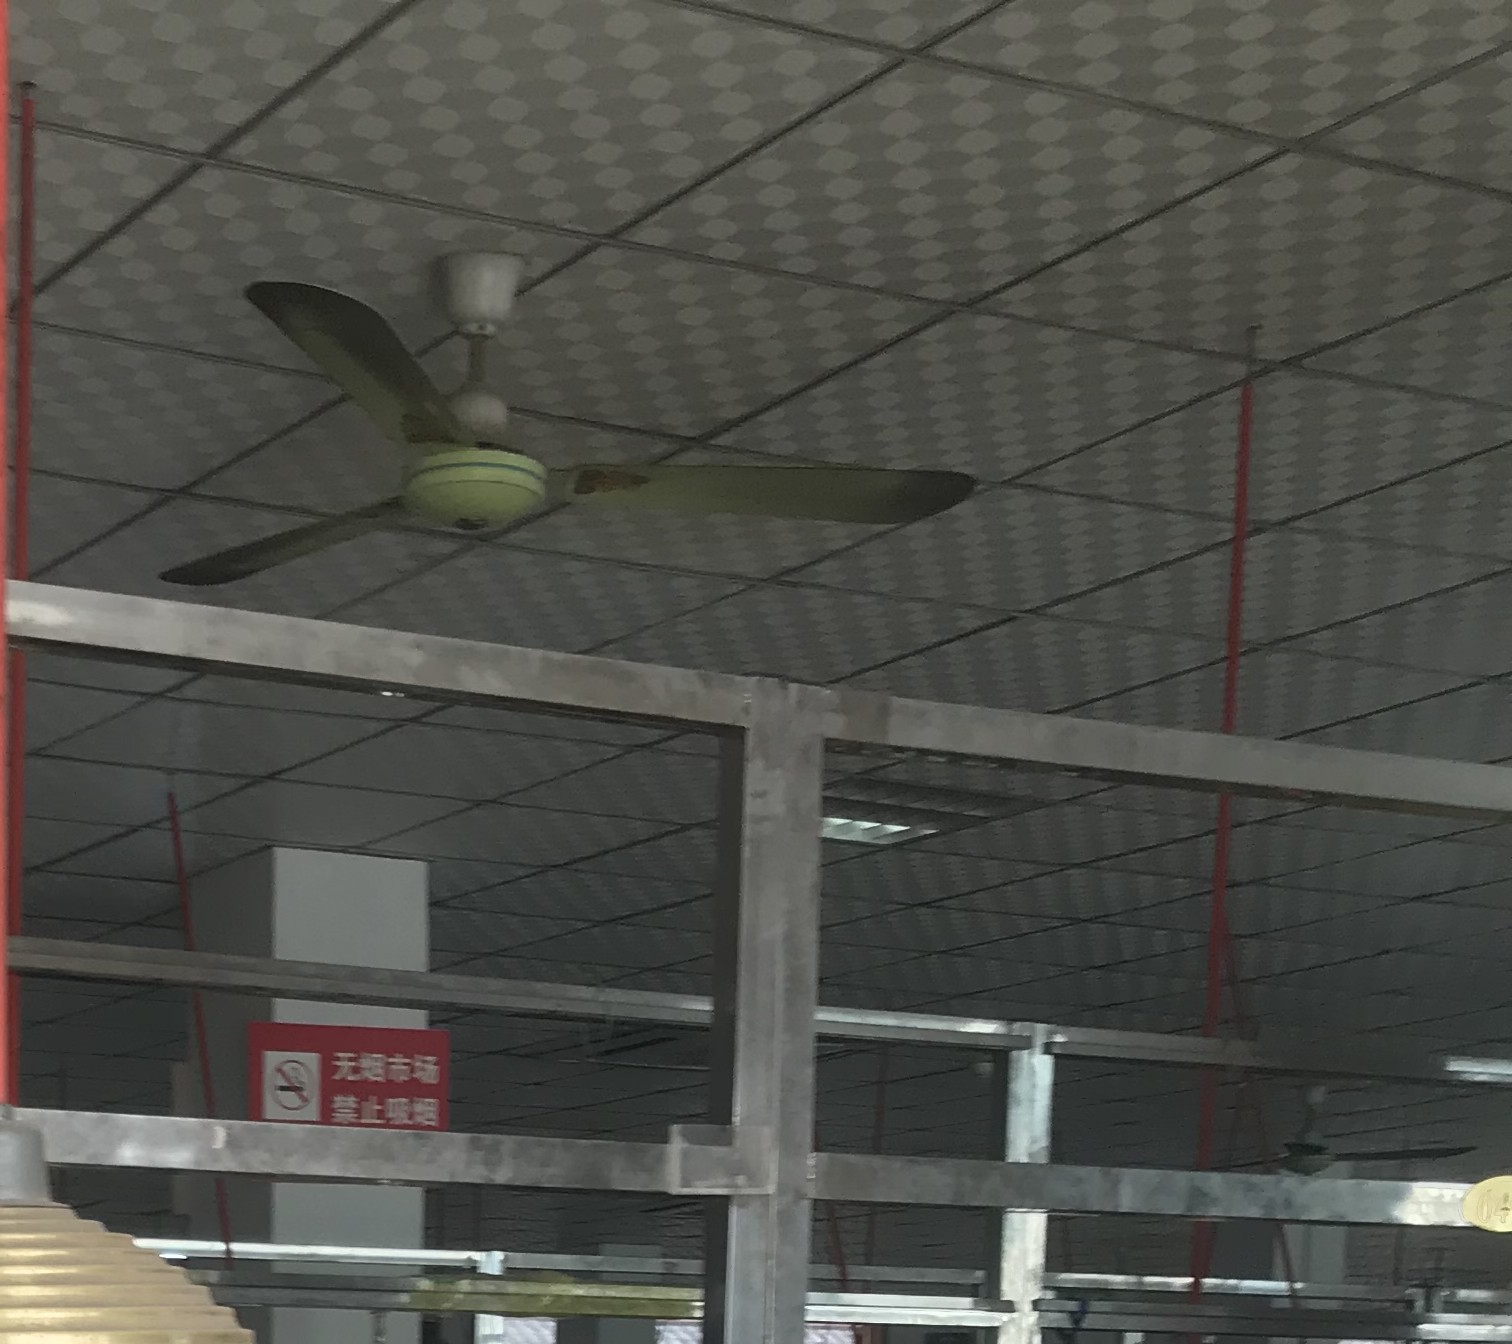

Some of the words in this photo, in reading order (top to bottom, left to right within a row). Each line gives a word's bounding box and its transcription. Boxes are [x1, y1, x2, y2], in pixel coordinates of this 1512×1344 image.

[331, 1052, 440, 1084] 无烟市场
[331, 1095, 439, 1126] 禁止吸烟
